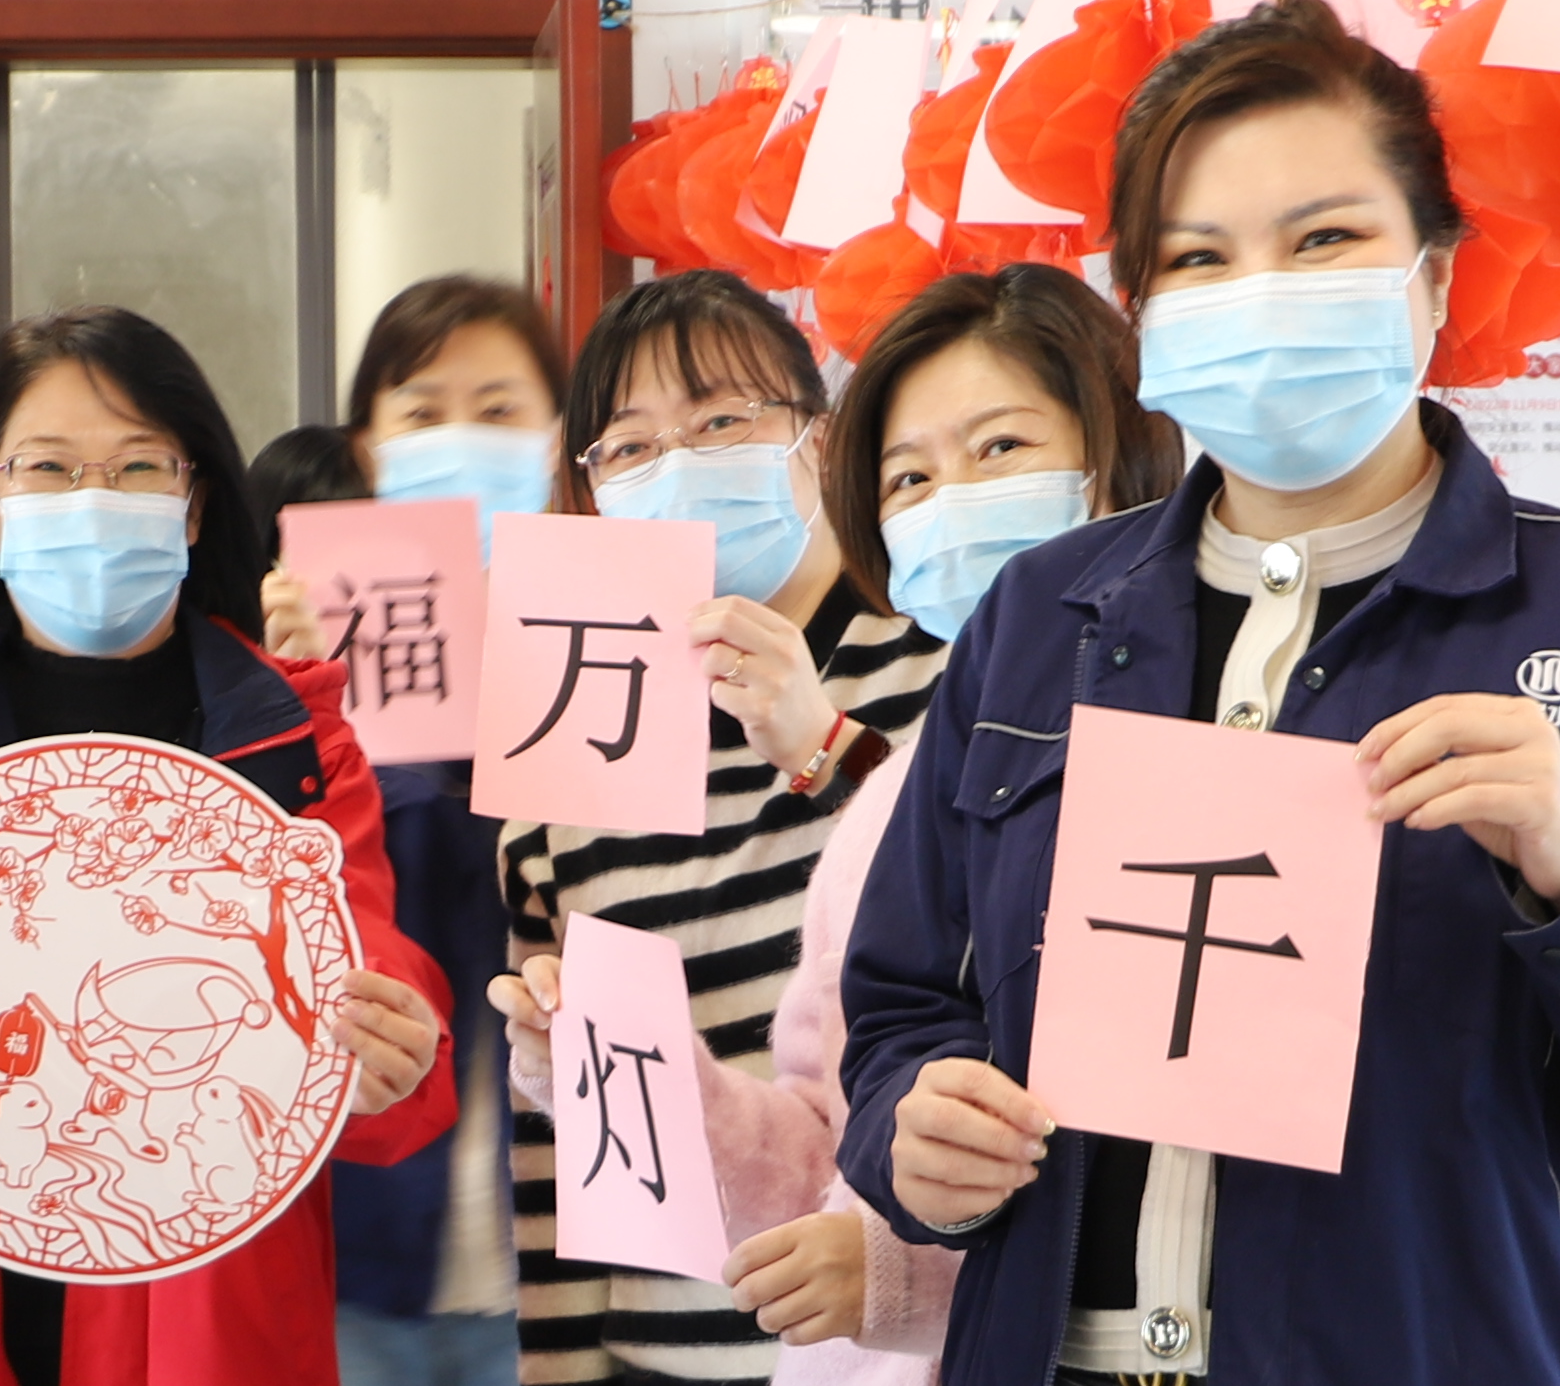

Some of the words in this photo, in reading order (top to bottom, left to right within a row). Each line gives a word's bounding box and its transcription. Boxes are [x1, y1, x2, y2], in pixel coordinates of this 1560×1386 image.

[321, 570, 451, 712] 福
[504, 614, 663, 764] 万
[1085, 850, 1304, 1061] 千
[3, 1030, 30, 1056] 福
[577, 1015, 668, 1205] 灯
